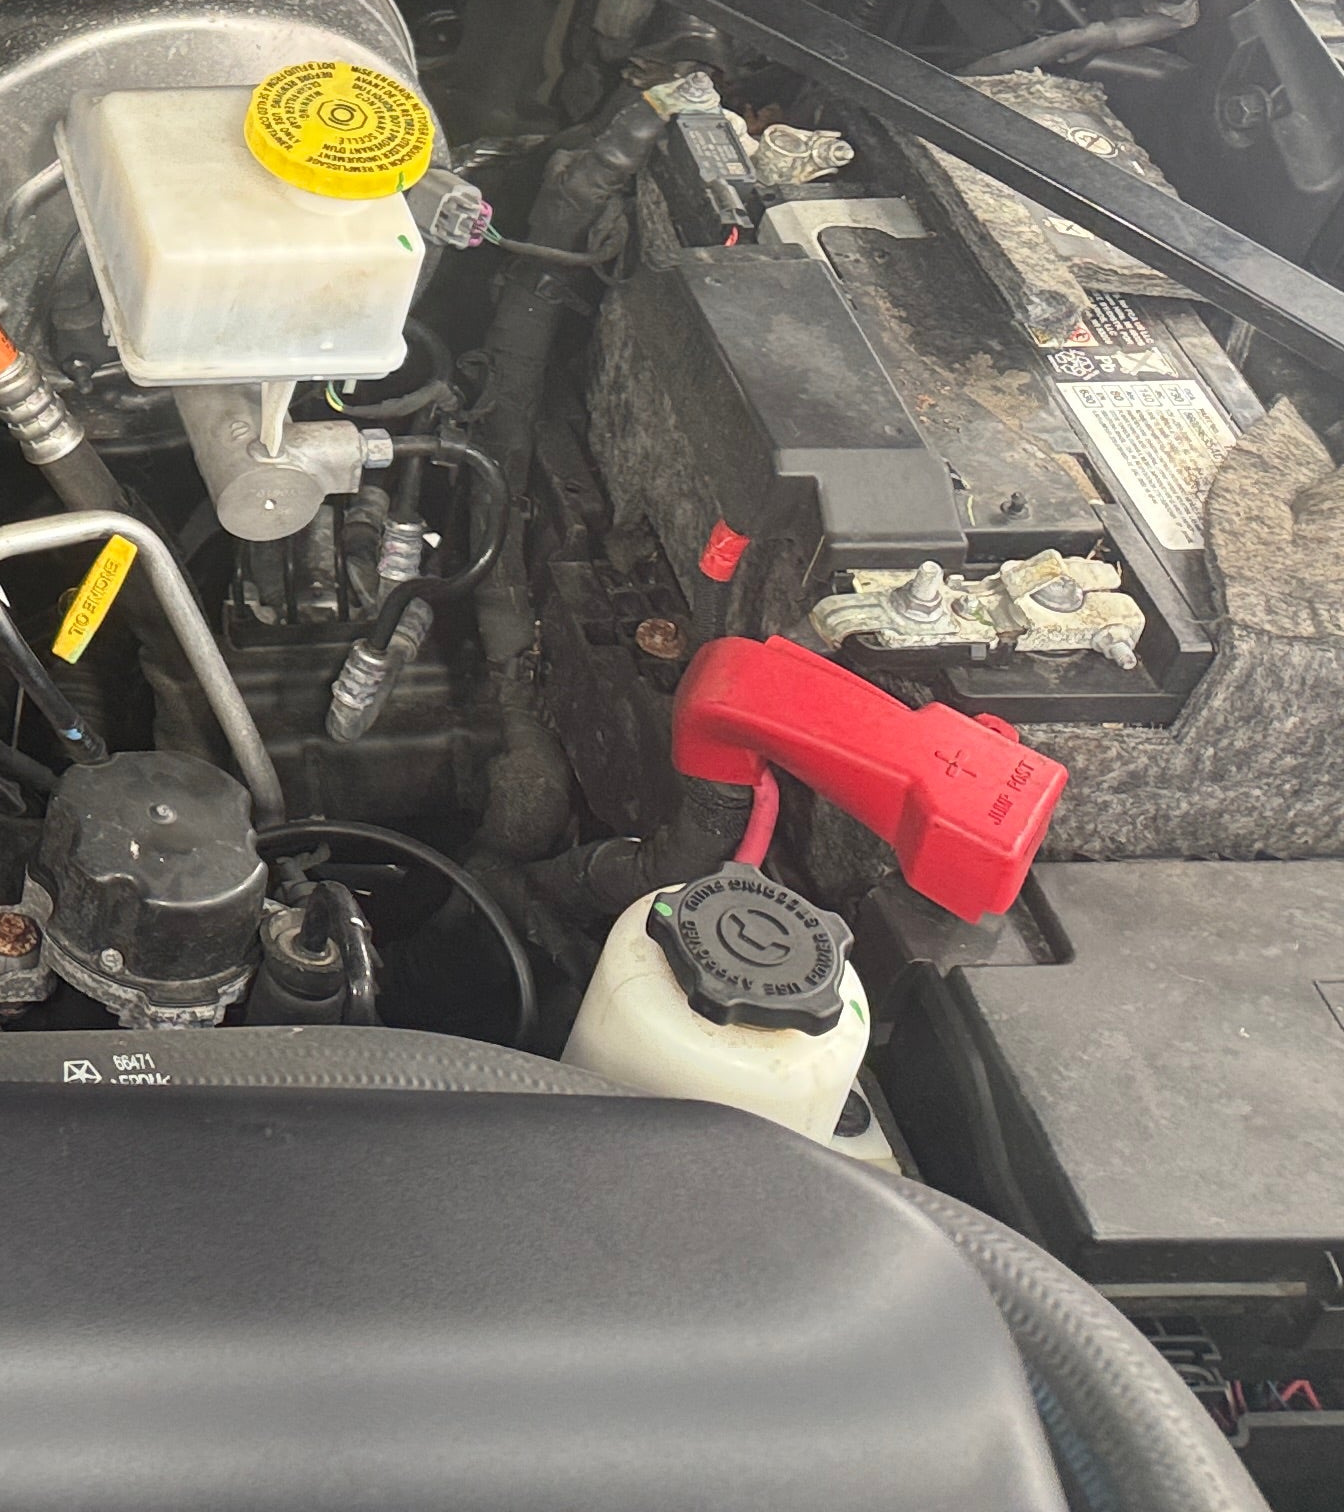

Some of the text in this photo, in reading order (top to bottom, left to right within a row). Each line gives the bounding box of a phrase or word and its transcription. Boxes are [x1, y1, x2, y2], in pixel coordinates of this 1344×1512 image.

[284, 65, 309, 76] FLUID
[317, 62, 336, 70] DOT
[266, 73, 287, 88] FROM
[296, 71, 333, 83] BEFORE
[354, 76, 387, 91] AVANT
[352, 83, 367, 92] DU
[383, 89, 397, 99] DE
[284, 93, 300, 114] FILLER
[392, 99, 407, 107] LE
[271, 112, 286, 125] USE
[305, 65, 429, 173] MISE EN GARDE NETTOYER LE BOUCHON DE REMPLISSAGE
[355, 92, 386, 136] CONTENANT
[389, 115, 402, 129] DOT
[286, 116, 302, 129] CAP
[258, 116, 293, 152] CONTAINER
[279, 127, 302, 144] ONLY
[322, 143, 346, 155] D'UN
[349, 132, 399, 155] PROVENANT
[381, 136, 411, 159] UTILISER
[318, 152, 383, 164] UNIQUEMENT
[1094, 355, 1116, 373] Pb
[67, 612, 90, 636] TO
[1006, 759, 1034, 792] POST
[727, 879, 820, 930] STEERING
[681, 919, 803, 996] USE APPROVED
[804, 932, 833, 987] POWER
